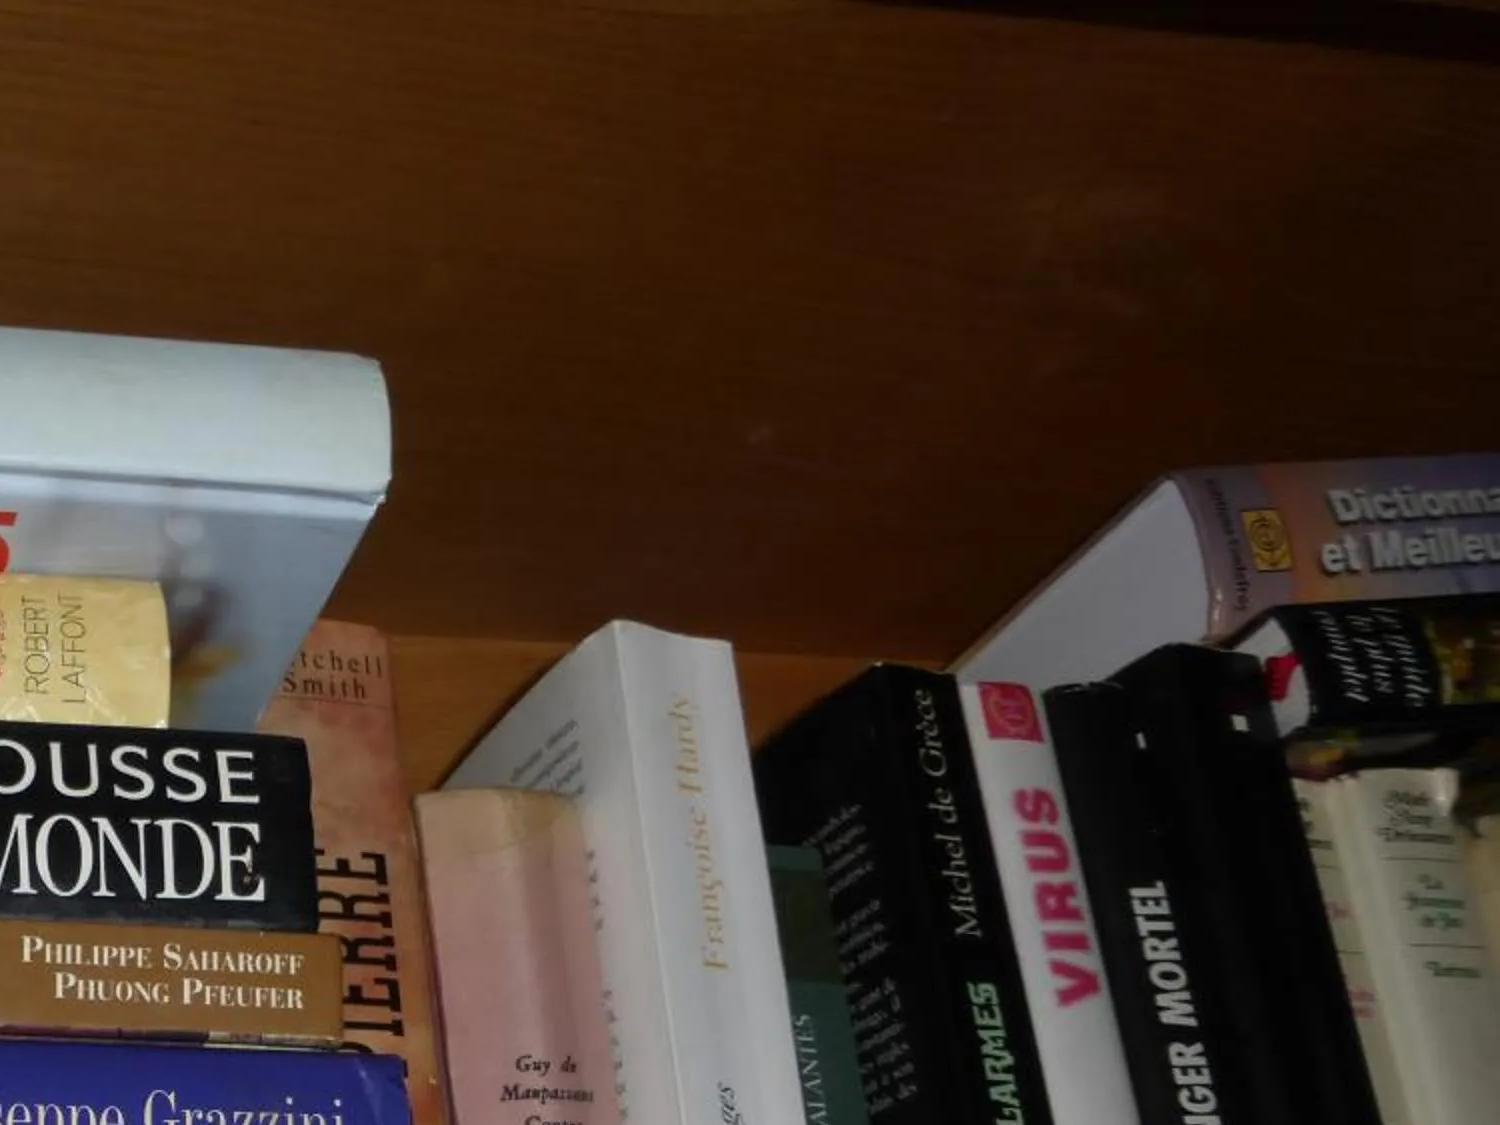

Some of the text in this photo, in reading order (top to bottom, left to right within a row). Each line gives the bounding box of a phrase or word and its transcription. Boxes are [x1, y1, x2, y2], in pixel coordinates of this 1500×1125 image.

[1320, 534, 1362, 574] et
[21, 595, 51, 695] ROBERT
[57, 591, 86, 704] LAFFONT
[292, 650, 382, 678] tchell
[283, 672, 366, 699] Smith
[927, 785, 959, 825] de
[932, 832, 984, 939] Michel
[1014, 787, 1101, 1007] VIRUS
[20, 935, 305, 976] PHILIPPE SAHAROFF
[1127, 878, 1200, 1028] MORTEL
[54, 971, 304, 1010] PHUONG PFEUFER
[515, 1055, 551, 1076] Guy
